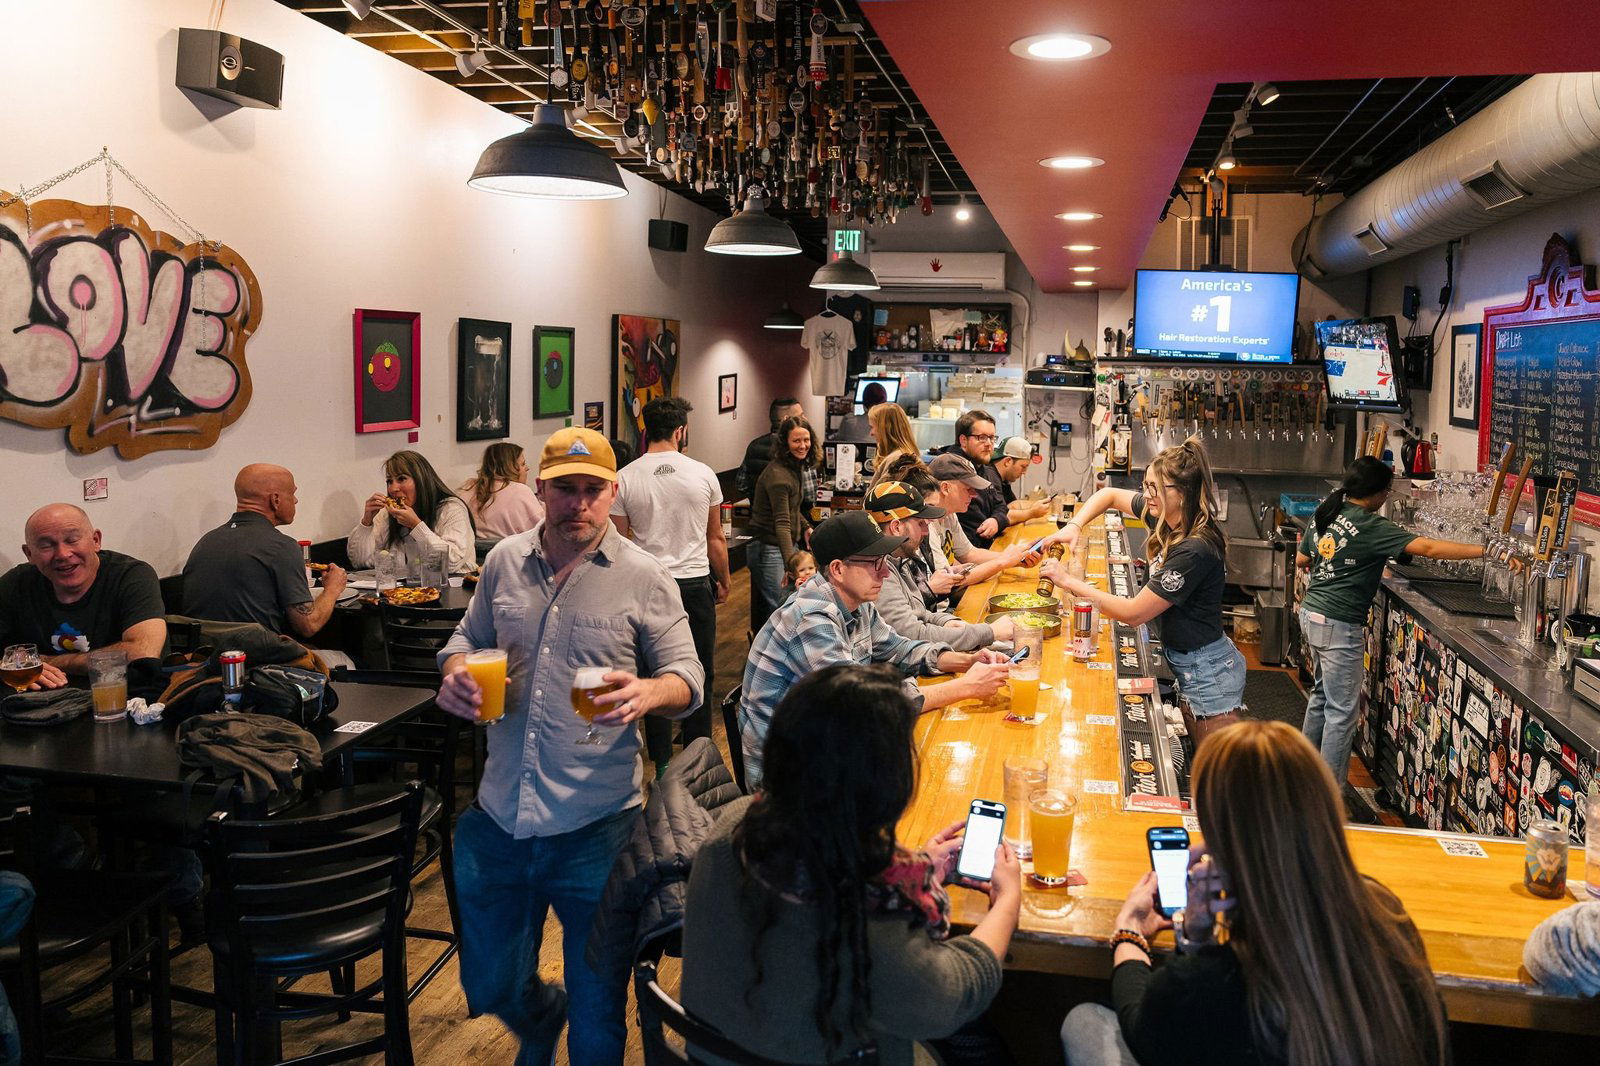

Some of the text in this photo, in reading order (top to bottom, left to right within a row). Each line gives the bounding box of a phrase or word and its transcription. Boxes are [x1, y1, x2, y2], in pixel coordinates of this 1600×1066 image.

[834, 230, 861, 251] EXIT
[1181, 278, 1253, 292] America's
[1190, 295, 1232, 332] #1
[1158, 332, 1178, 342] Hair
[1178, 333, 1232, 344] Restoration
[1124, 703, 1147, 722] Tito's
